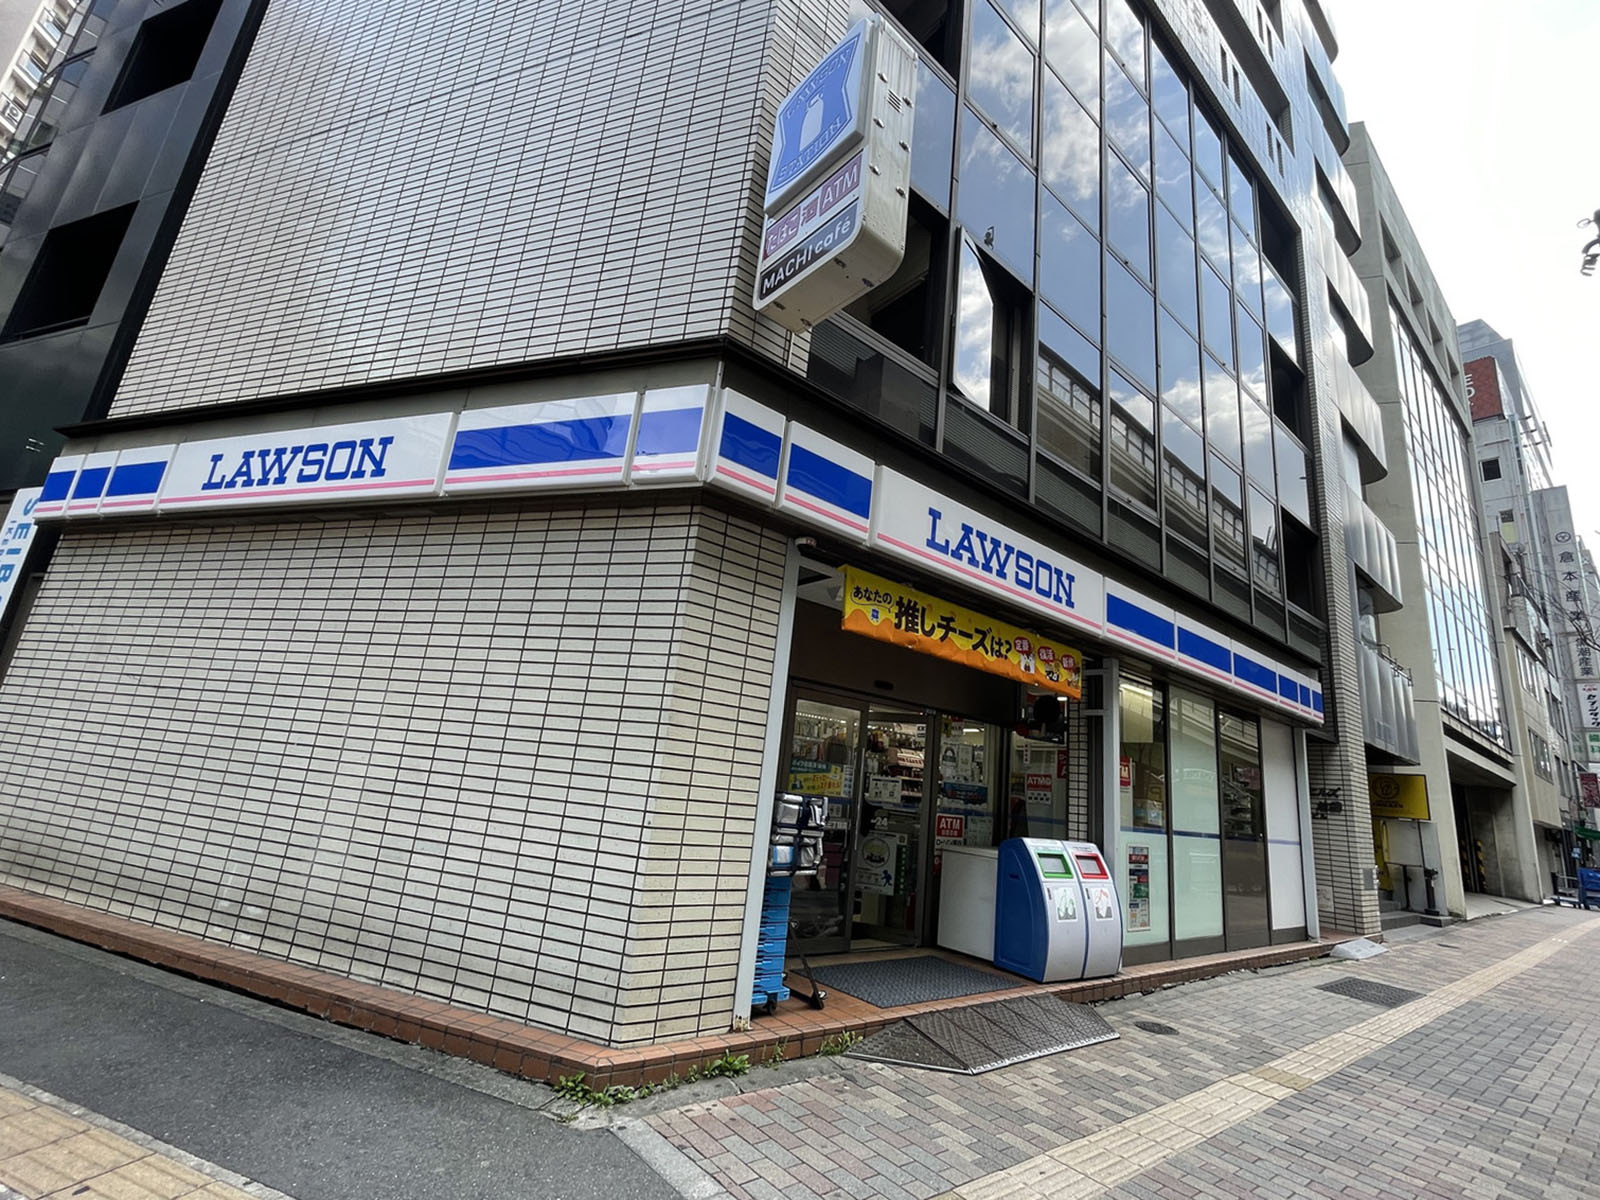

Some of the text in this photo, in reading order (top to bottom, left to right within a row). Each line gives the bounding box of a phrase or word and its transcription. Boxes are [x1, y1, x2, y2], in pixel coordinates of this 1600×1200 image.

[784, 48, 850, 120] LAWSON
[778, 115, 842, 181] STATION
[767, 212, 799, 252] たばこ
[822, 165, 858, 209] ATM
[763, 216, 851, 294] MACHI café
[201, 436, 394, 491] LAWSON
[0, 497, 39, 601] SEIB
[926, 507, 1075, 609] LAWSON
[853, 585, 893, 605] あなたの
[940, 817, 960, 830] ATM
